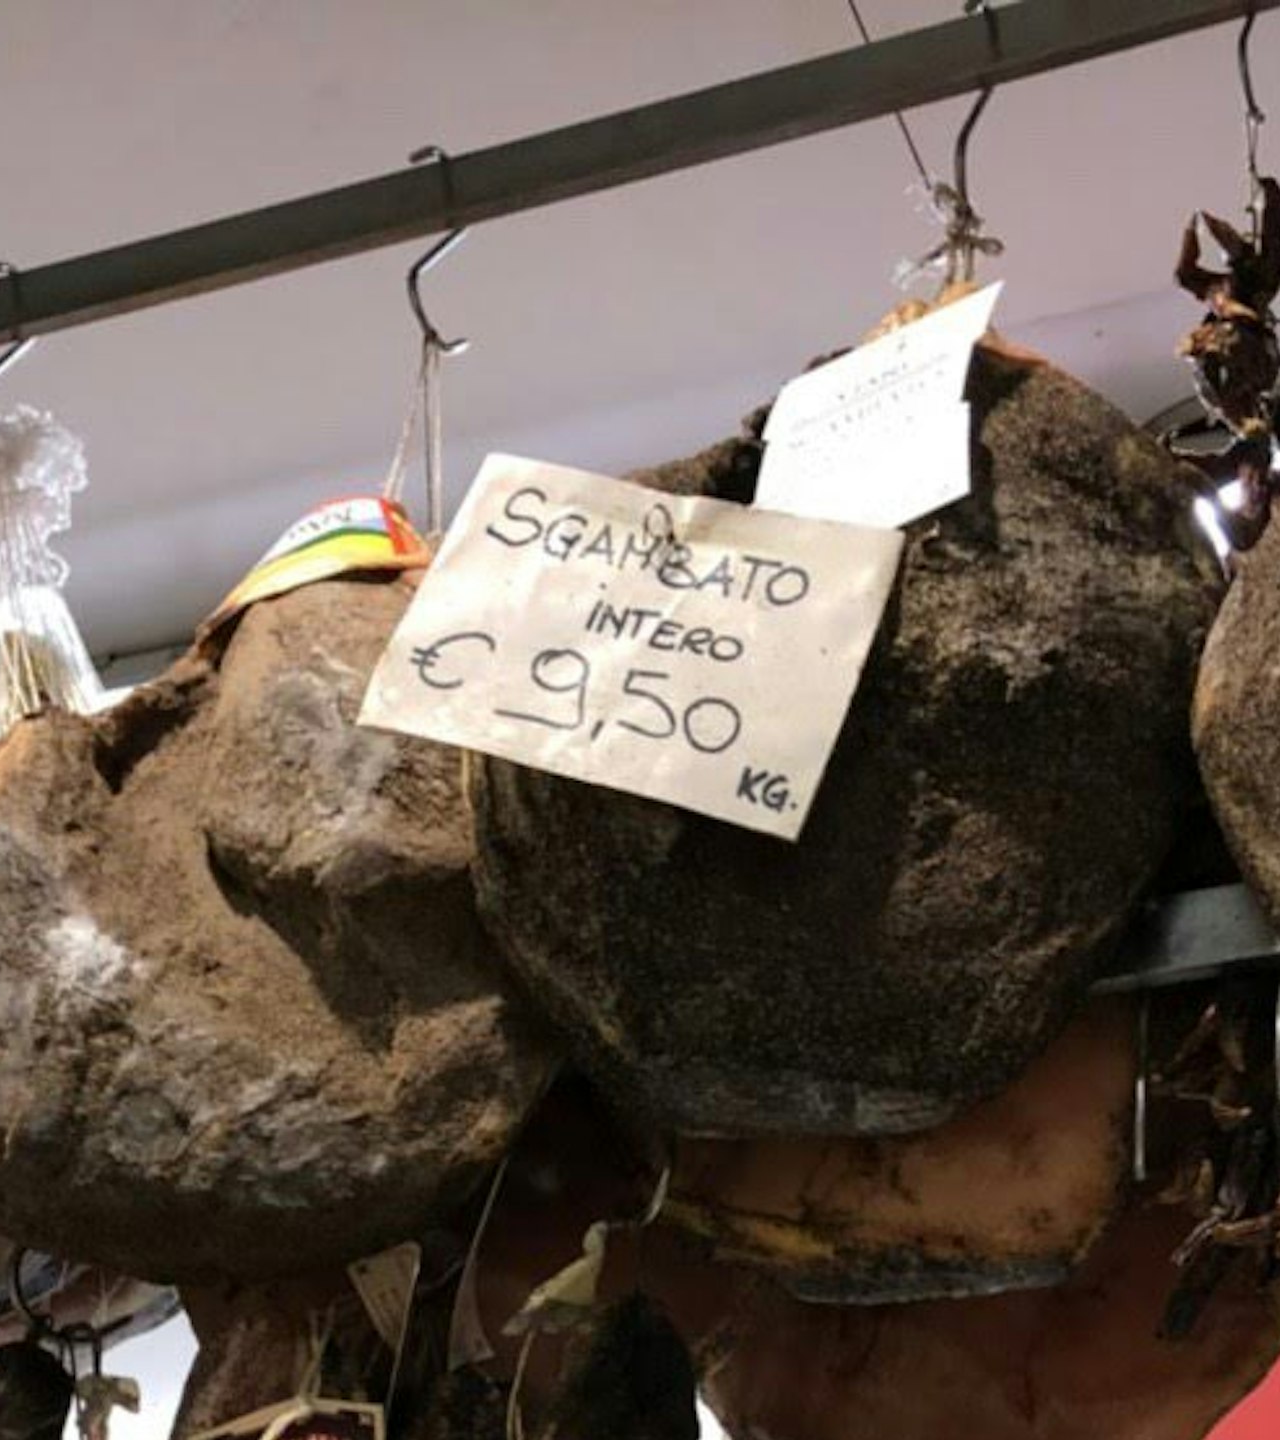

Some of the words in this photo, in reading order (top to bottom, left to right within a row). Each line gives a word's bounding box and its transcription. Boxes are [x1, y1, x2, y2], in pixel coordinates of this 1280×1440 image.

[487, 487, 809, 606] SGAMBATO
[586, 585, 745, 662] INTERO
[411, 632, 496, 689] €
[495, 649, 741, 753] 9,50
